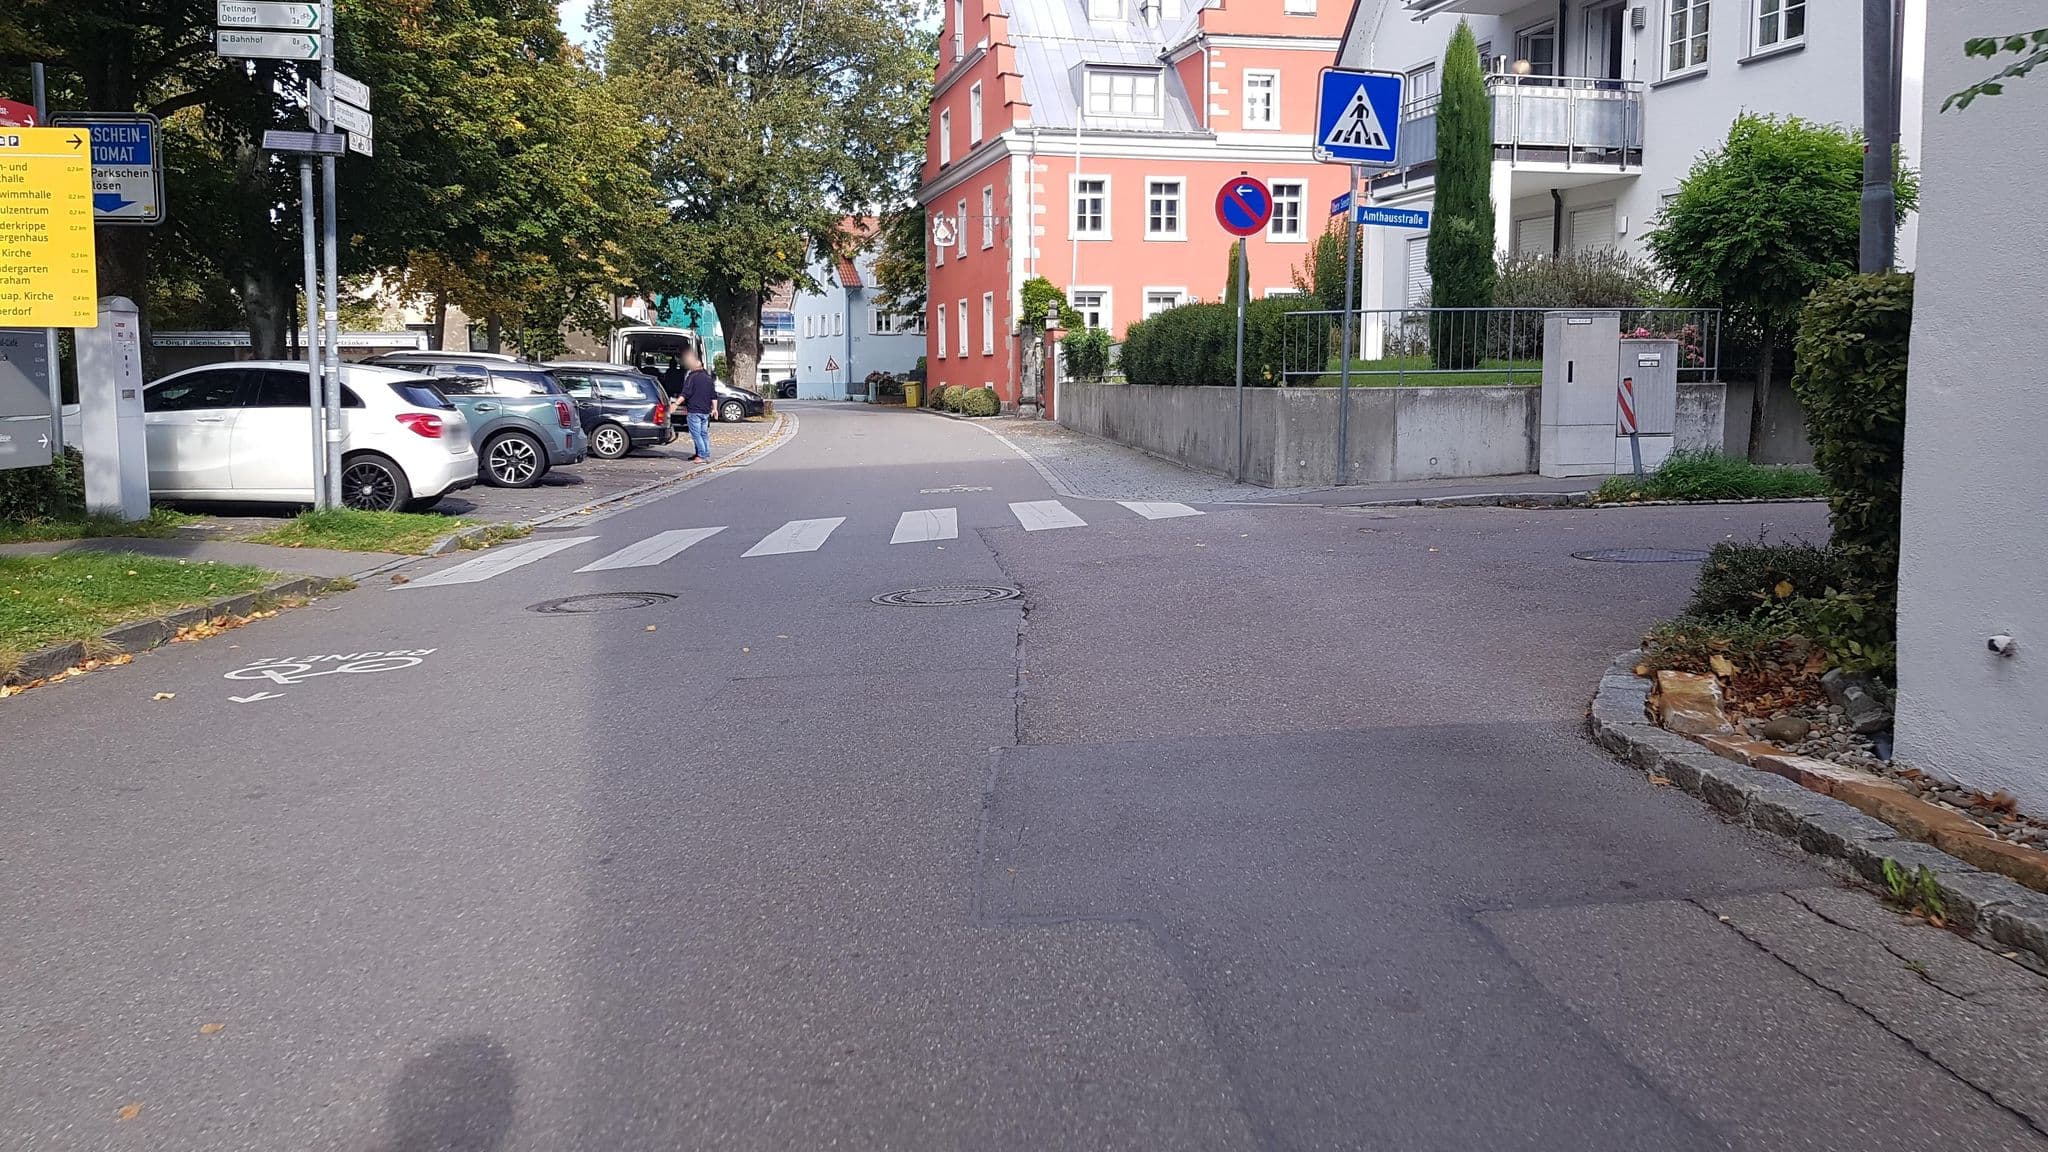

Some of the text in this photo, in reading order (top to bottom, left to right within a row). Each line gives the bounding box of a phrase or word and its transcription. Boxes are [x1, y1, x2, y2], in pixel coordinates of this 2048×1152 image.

[221, 4, 256, 14] Tettnang
[221, 14, 257, 23] Oberdorf
[230, 35, 263, 44] Bahnhof
[92, 146, 135, 162] TOMAT
[9, 163, 28, 171] und
[91, 168, 149, 179] Parkschein
[92, 180, 121, 191] lösen
[0, 206, 49, 215] ulzentrum
[1362, 210, 1424, 225] Amthausstraße
[0, 221, 46, 233] derkrippe
[2, 248, 32, 258] Kirche
[1, 293, 22, 302] uap.
[24, 291, 54, 301] Kirche
